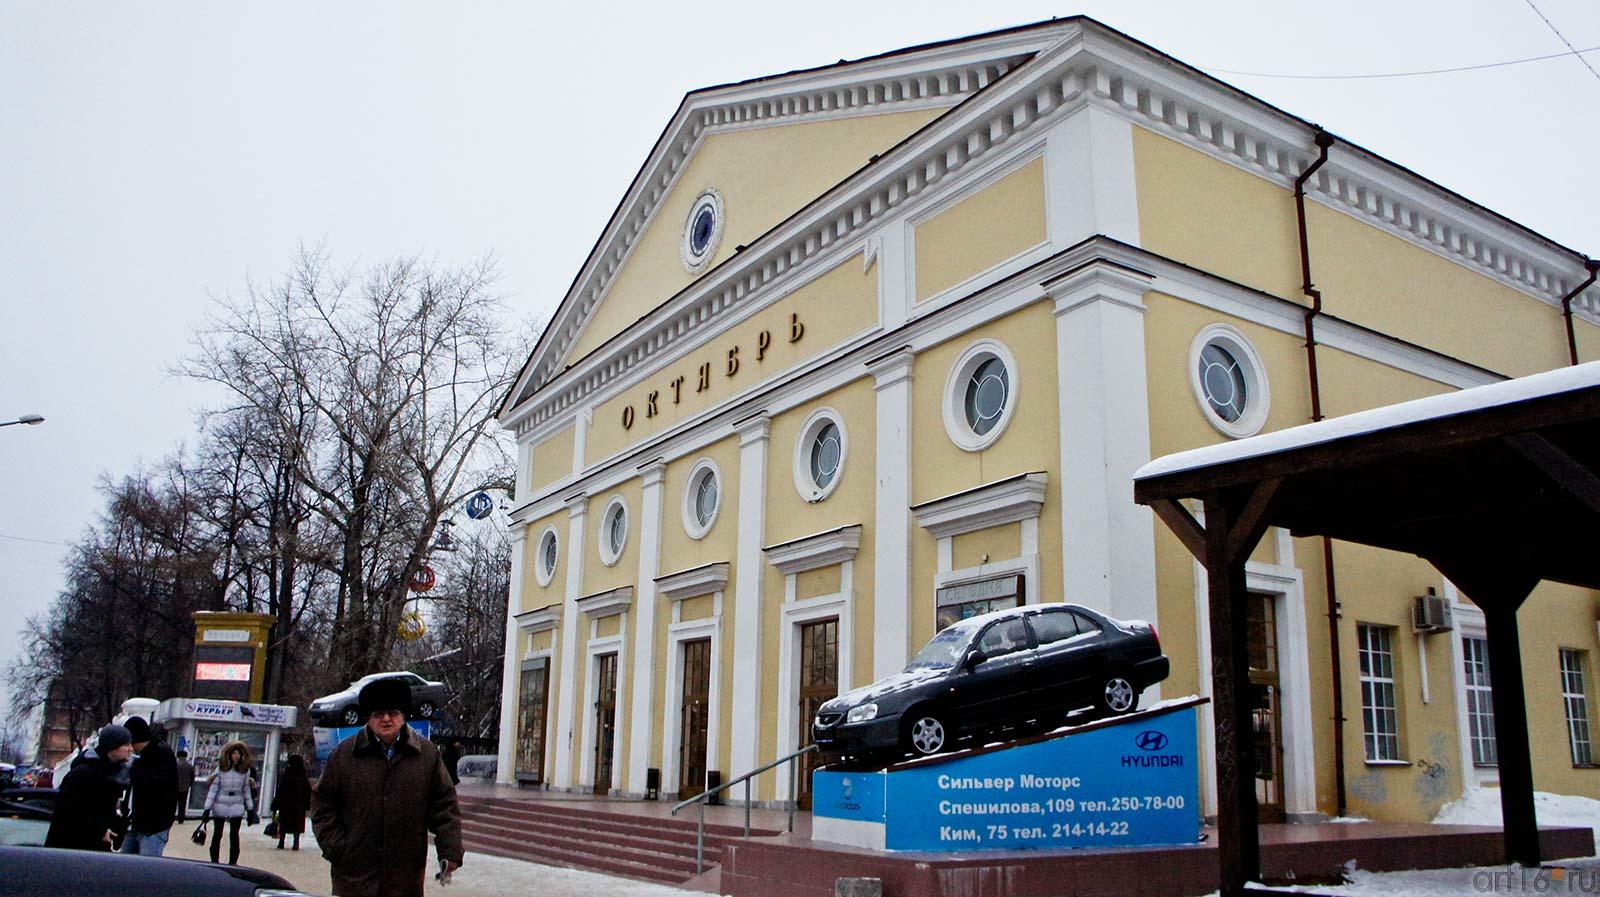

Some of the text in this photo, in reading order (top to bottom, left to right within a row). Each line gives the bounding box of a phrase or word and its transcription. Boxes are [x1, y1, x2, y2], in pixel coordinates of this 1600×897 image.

[621, 312, 806, 430] ОКТЯБРЬ
[196, 706, 234, 716] КУРЬЕР
[1121, 755, 1184, 768] HYUNDAI
[937, 774, 1081, 792] Сильвер Моторс
[940, 821, 1129, 843] Ким, 75 тел. 214-14-22
